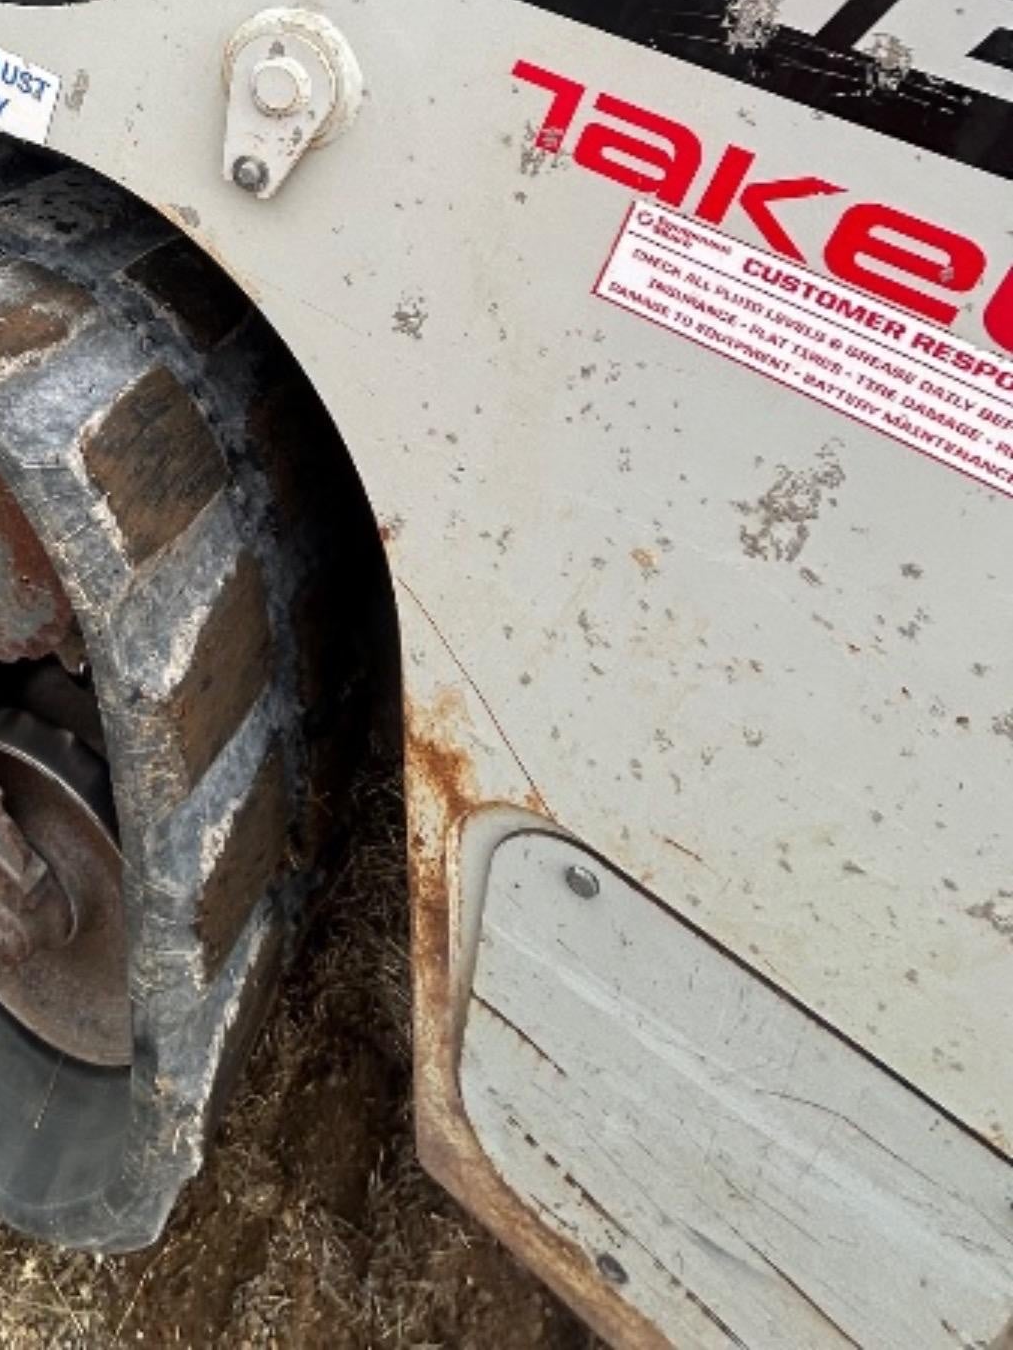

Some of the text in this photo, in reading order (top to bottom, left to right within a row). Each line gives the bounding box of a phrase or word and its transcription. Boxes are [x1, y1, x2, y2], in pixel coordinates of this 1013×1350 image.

[511, 59, 1013, 354] Take
[684, 272, 710, 292] ALL
[844, 344, 917, 385] GREASE
[919, 380, 974, 412] DAILY
[743, 257, 906, 340] CUSTOMER
[674, 310, 693, 328] TO
[803, 370, 881, 415] BATTERY
[856, 373, 897, 401] TIRE
[900, 395, 984, 442] DAMAGE
